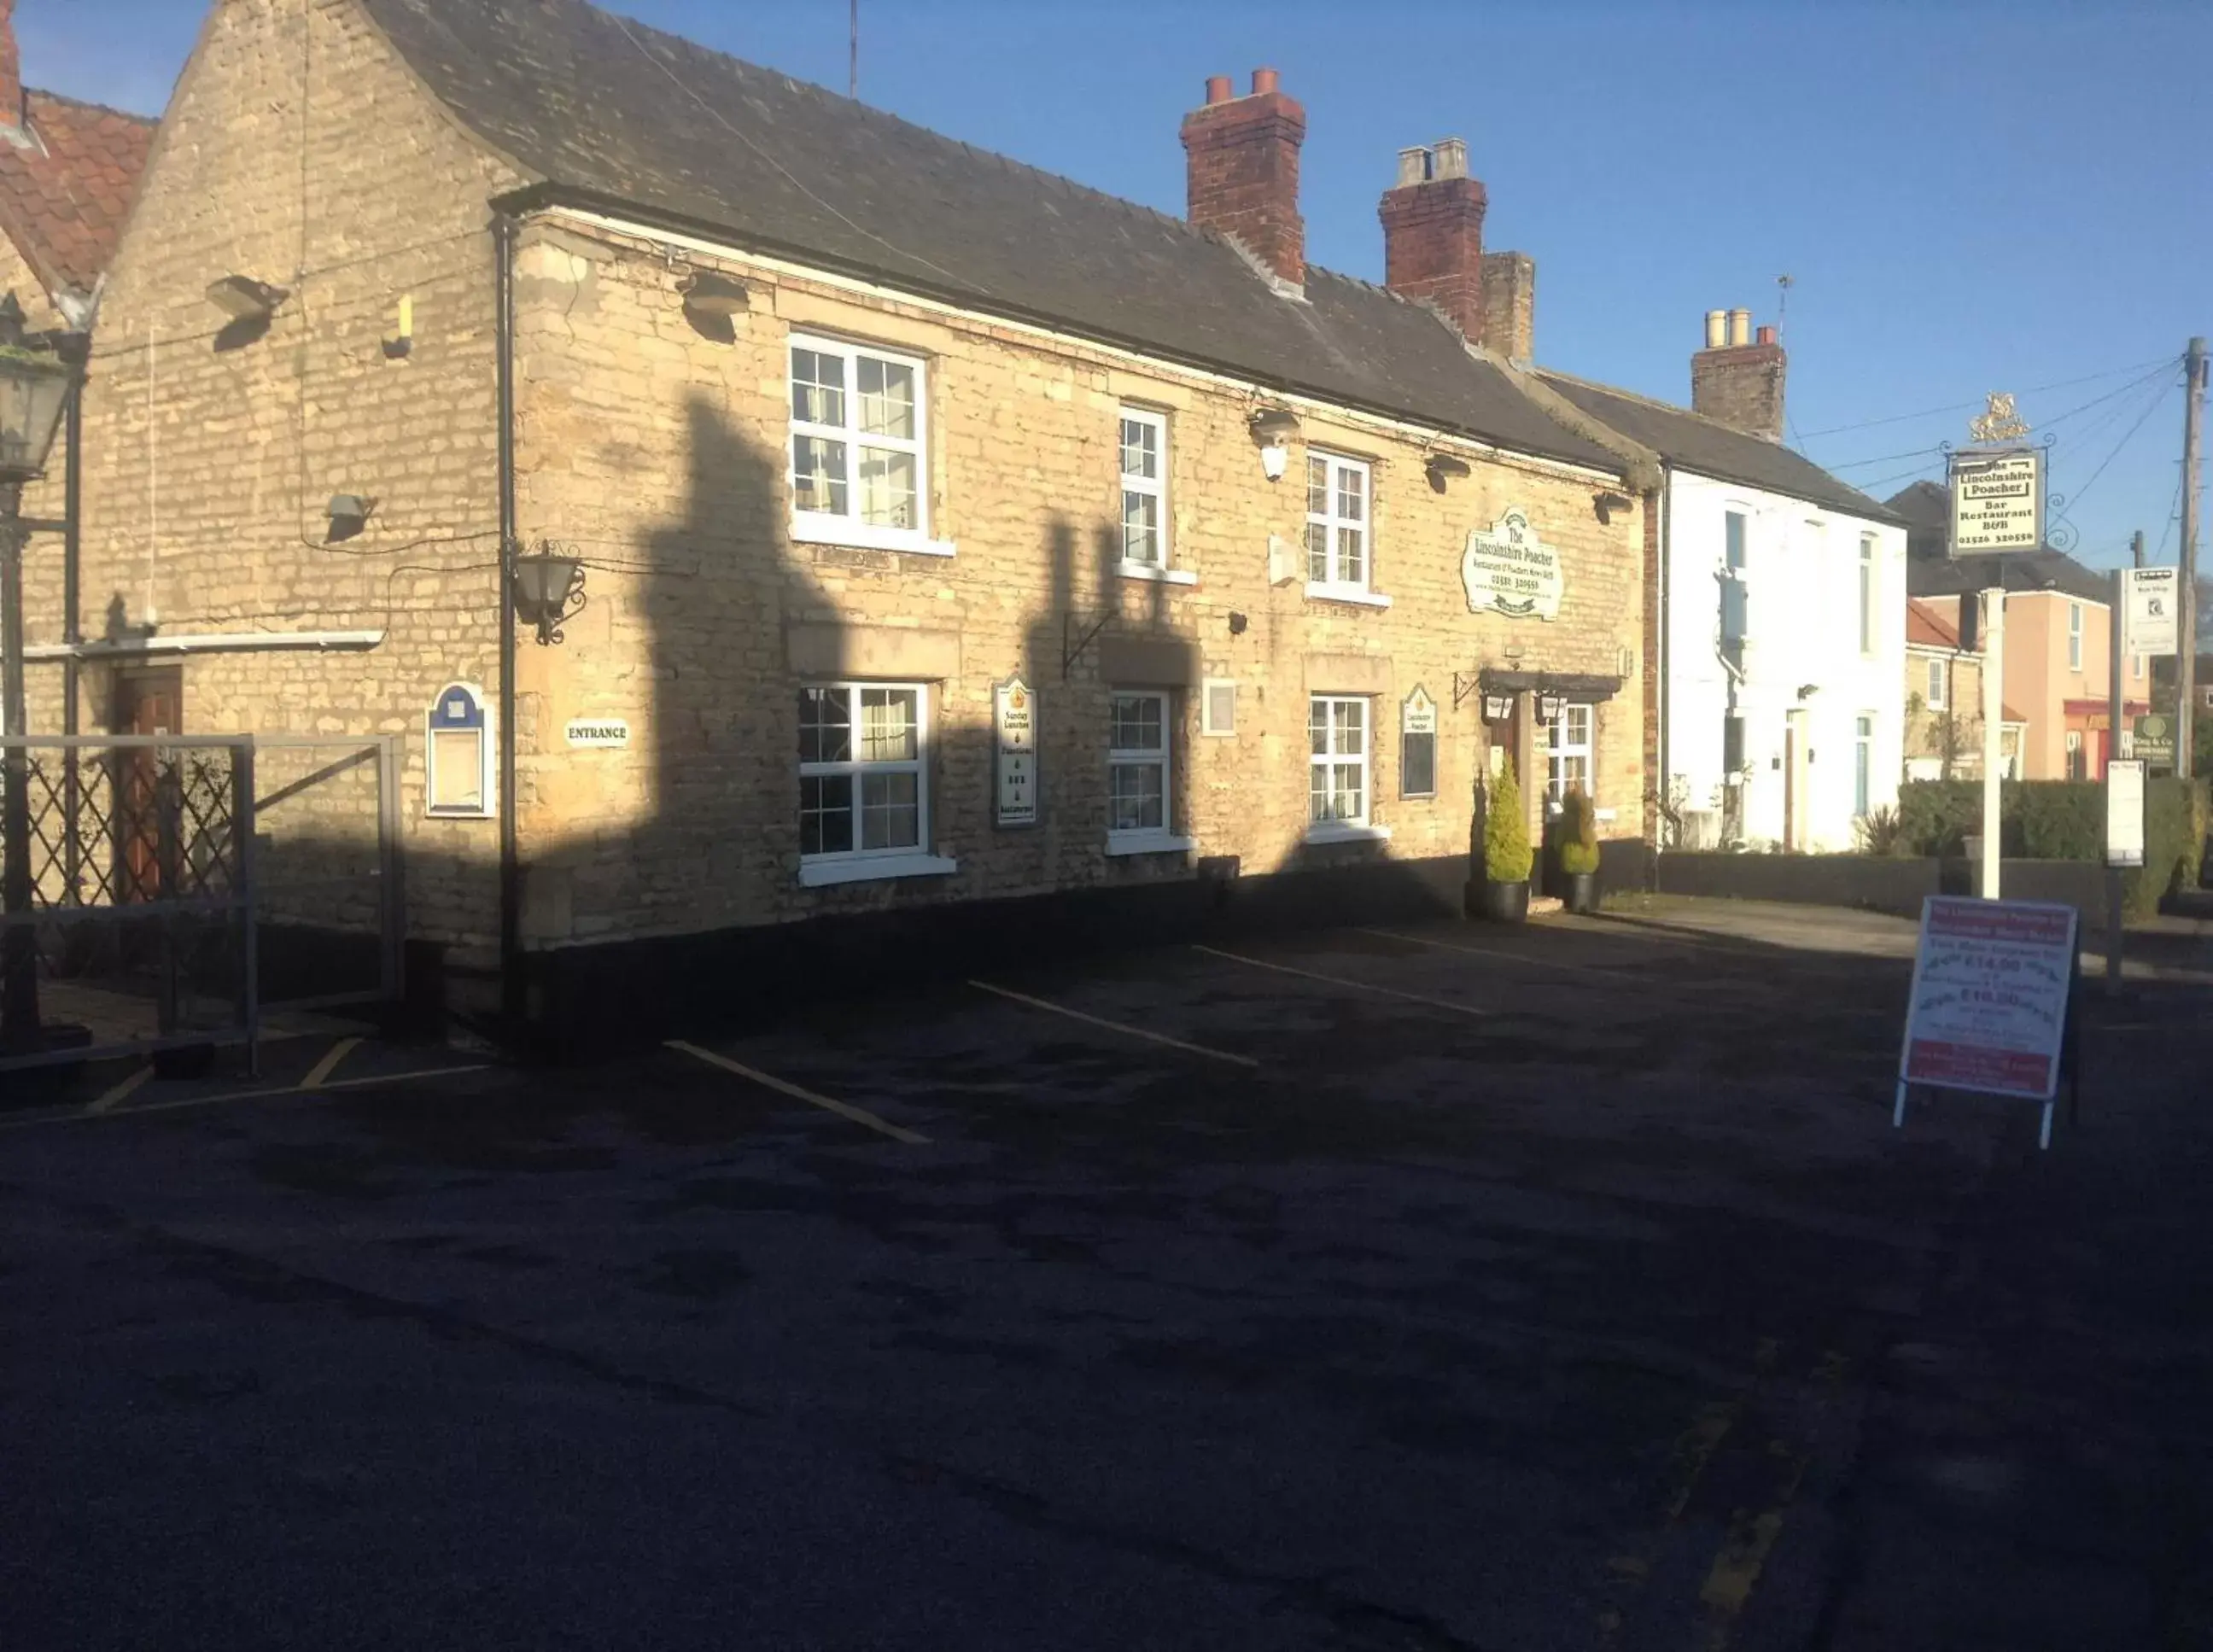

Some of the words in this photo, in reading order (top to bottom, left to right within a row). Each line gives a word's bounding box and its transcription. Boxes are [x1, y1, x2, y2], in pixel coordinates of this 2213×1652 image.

[1988, 461, 2007, 470] The
[1960, 471, 2034, 484] Lincolnshire
[1972, 483, 2022, 494] Poacher
[1985, 501, 2007, 510] Bar
[1960, 509, 2032, 521] Restaurant
[1982, 521, 2008, 530] B&B
[1509, 528, 1523, 544] The
[1475, 537, 1522, 561] Lincolnshire
[1524, 546, 1553, 566] Poacher
[569, 727, 627, 739] ENTRANCE
